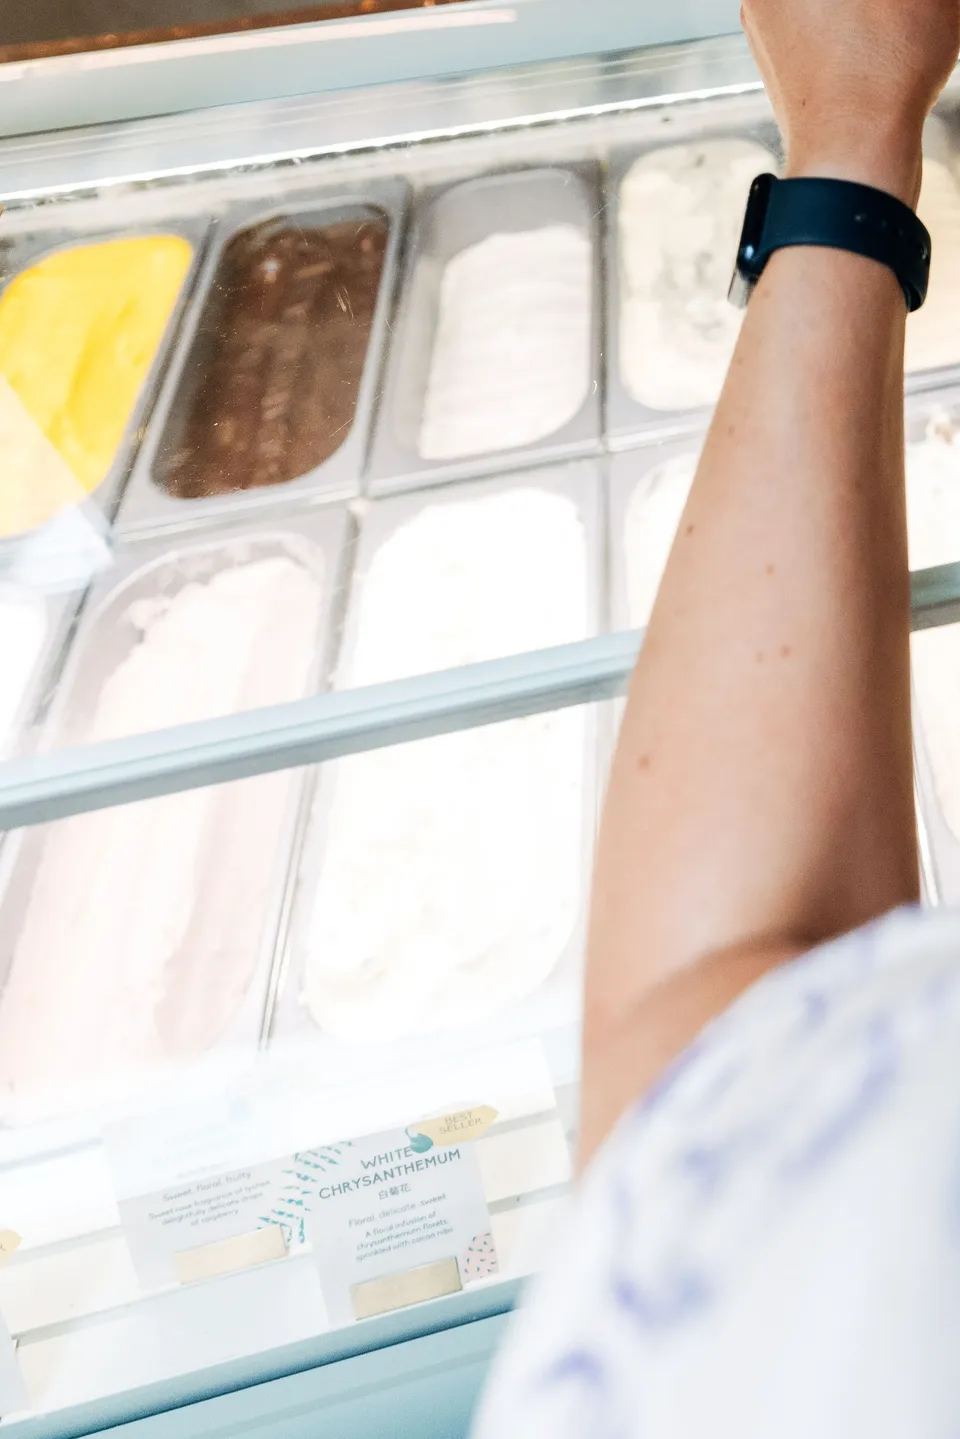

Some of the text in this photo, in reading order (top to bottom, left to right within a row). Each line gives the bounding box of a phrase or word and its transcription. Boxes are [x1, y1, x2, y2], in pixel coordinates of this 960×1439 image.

[439, 1118, 483, 1134] SELLER
[444, 1111, 472, 1125] BEST
[360, 1146, 413, 1170] WHITE
[319, 1148, 461, 1199] CHRYSANTHEMUM
[378, 1183, 411, 1200] 白菊花
[395, 1216, 426, 1229] infusion
[428, 1211, 436, 1219] of
[356, 1227, 422, 1251] chrysanthemum
[393, 1239, 410, 1250] with
